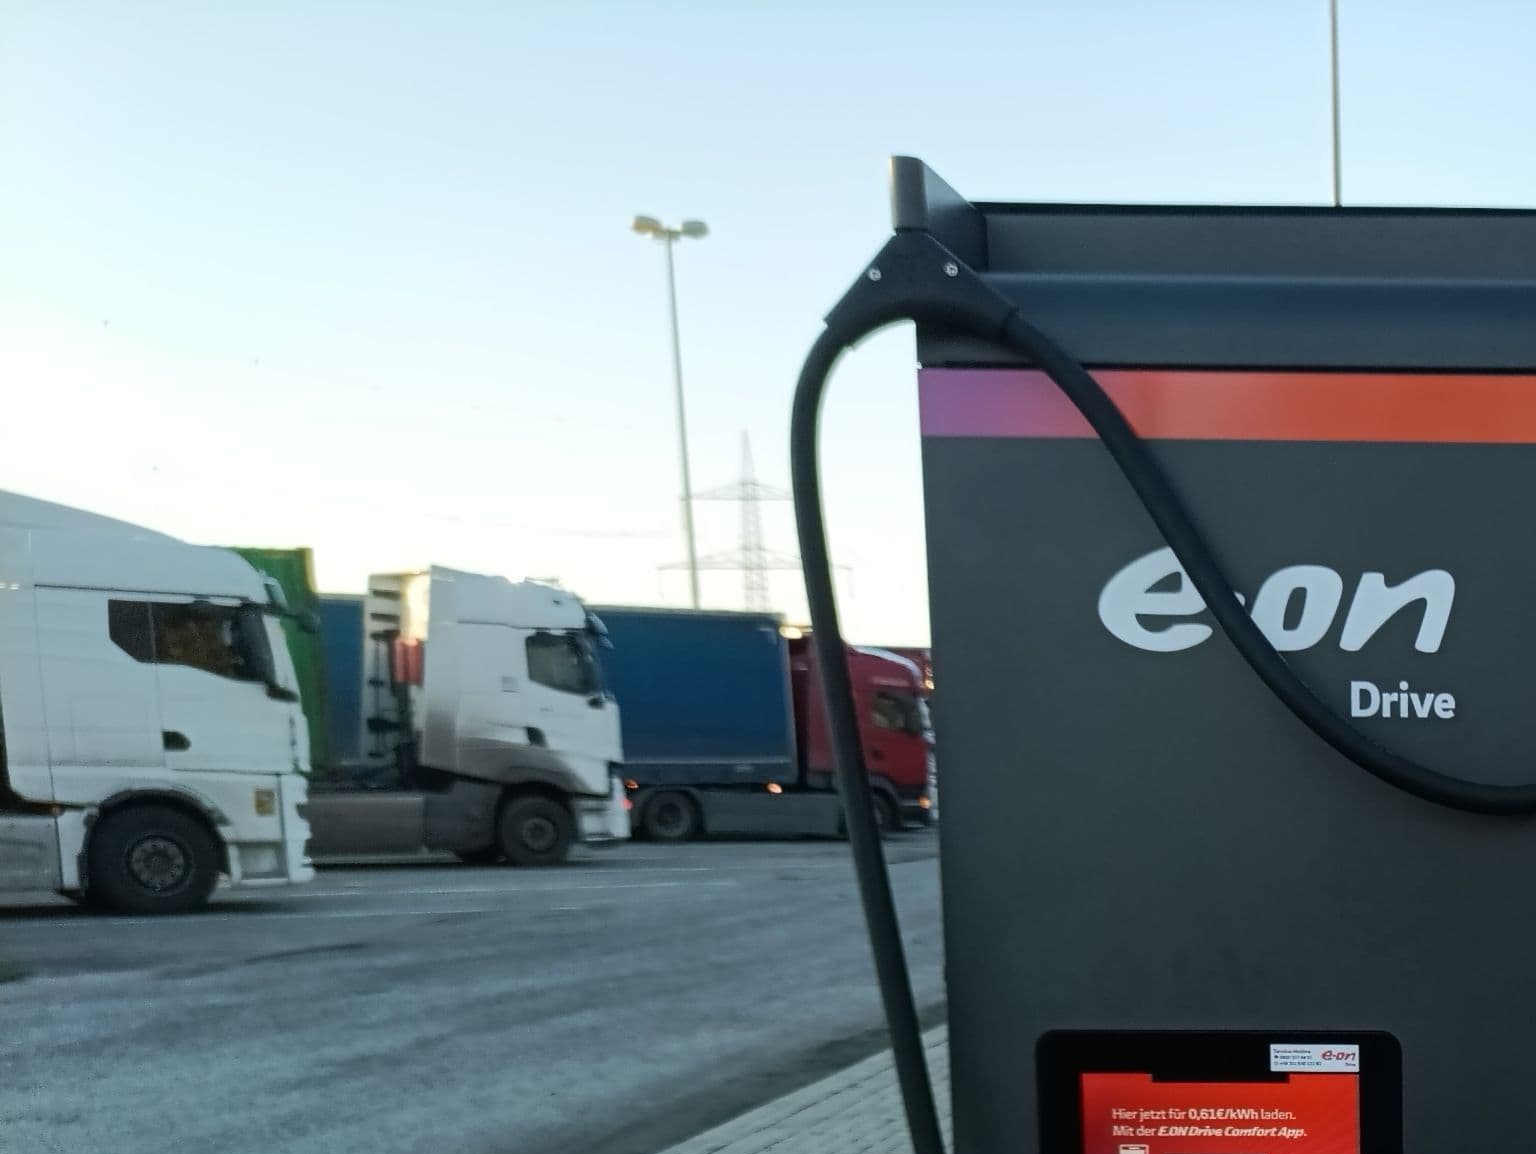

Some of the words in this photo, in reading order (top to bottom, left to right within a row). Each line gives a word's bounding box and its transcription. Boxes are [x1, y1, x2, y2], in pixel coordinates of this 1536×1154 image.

[1350, 680, 1456, 719] Drive
[1111, 1107, 1137, 1120] Hier
[1139, 1107, 1167, 1123] jetzt
[1168, 1107, 1187, 1120] für
[1188, 1107, 1259, 1121] 0,61€/kWh
[1260, 1107, 1297, 1120] laden.
[1112, 1125, 1134, 1137] Mit
[1136, 1125, 1156, 1137] der
[1187, 1125, 1223, 1137] Drive
[1223, 1125, 1278, 1137] Comfort
